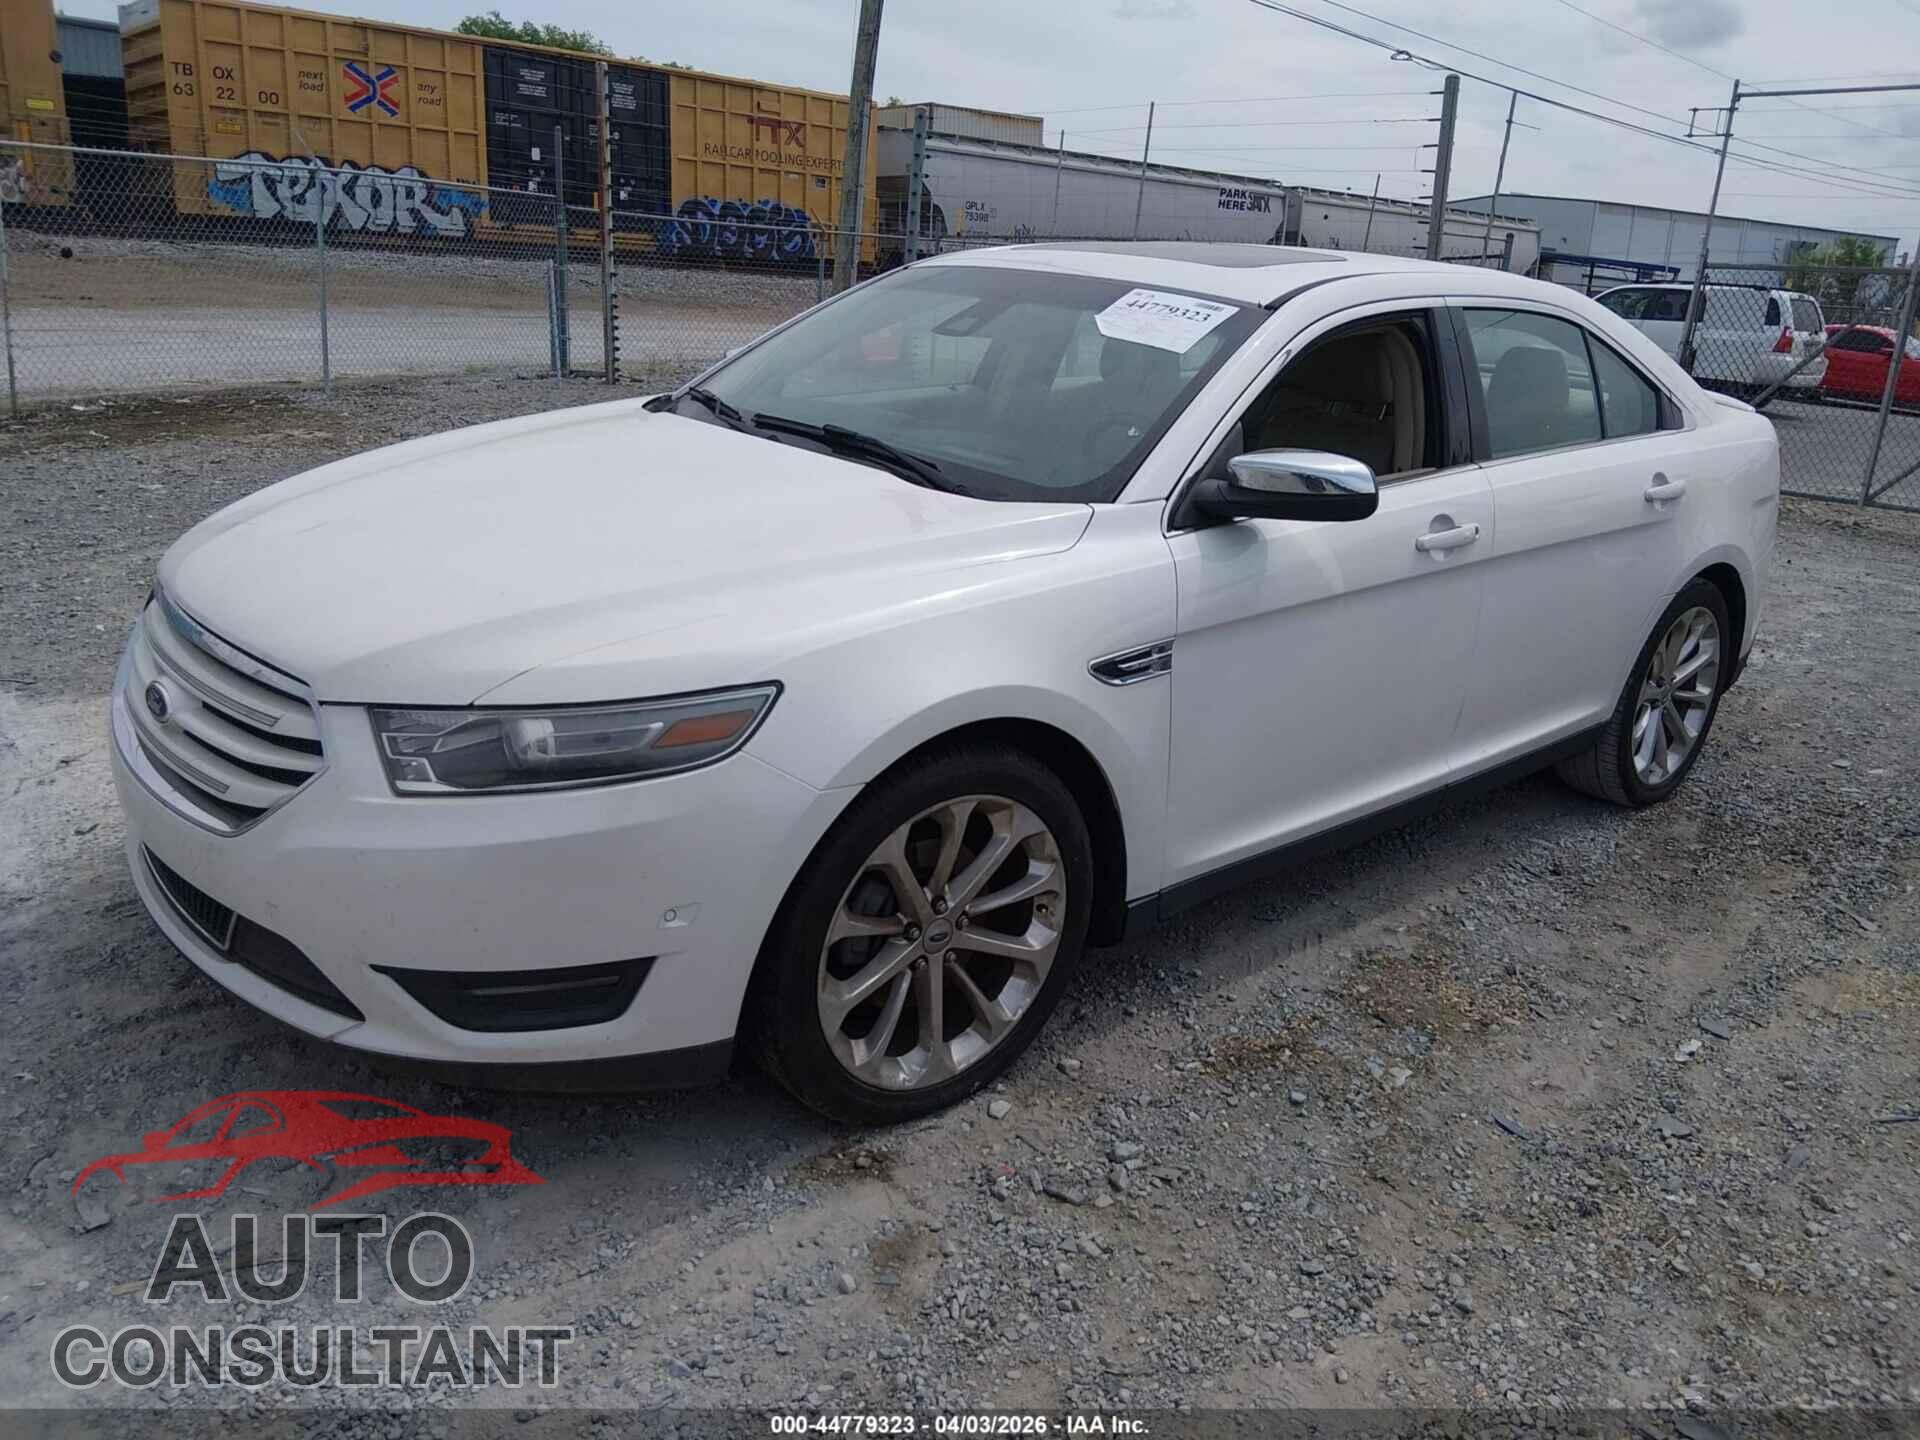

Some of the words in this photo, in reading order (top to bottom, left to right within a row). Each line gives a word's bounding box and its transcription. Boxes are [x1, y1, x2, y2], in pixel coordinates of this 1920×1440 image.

[174, 63, 193, 76] TB
[212, 66, 235, 81] OX
[298, 70, 324, 81] next
[299, 80, 325, 92] load
[417, 83, 436, 94] any
[173, 83, 194, 96] 63
[216, 87, 235, 100] 22
[258, 91, 280, 105] 00
[418, 96, 442, 106] road
[1219, 187, 1247, 200] PARK
[1218, 199, 1247, 211] HERE
[1126, 299, 1212, 323] 44779323
